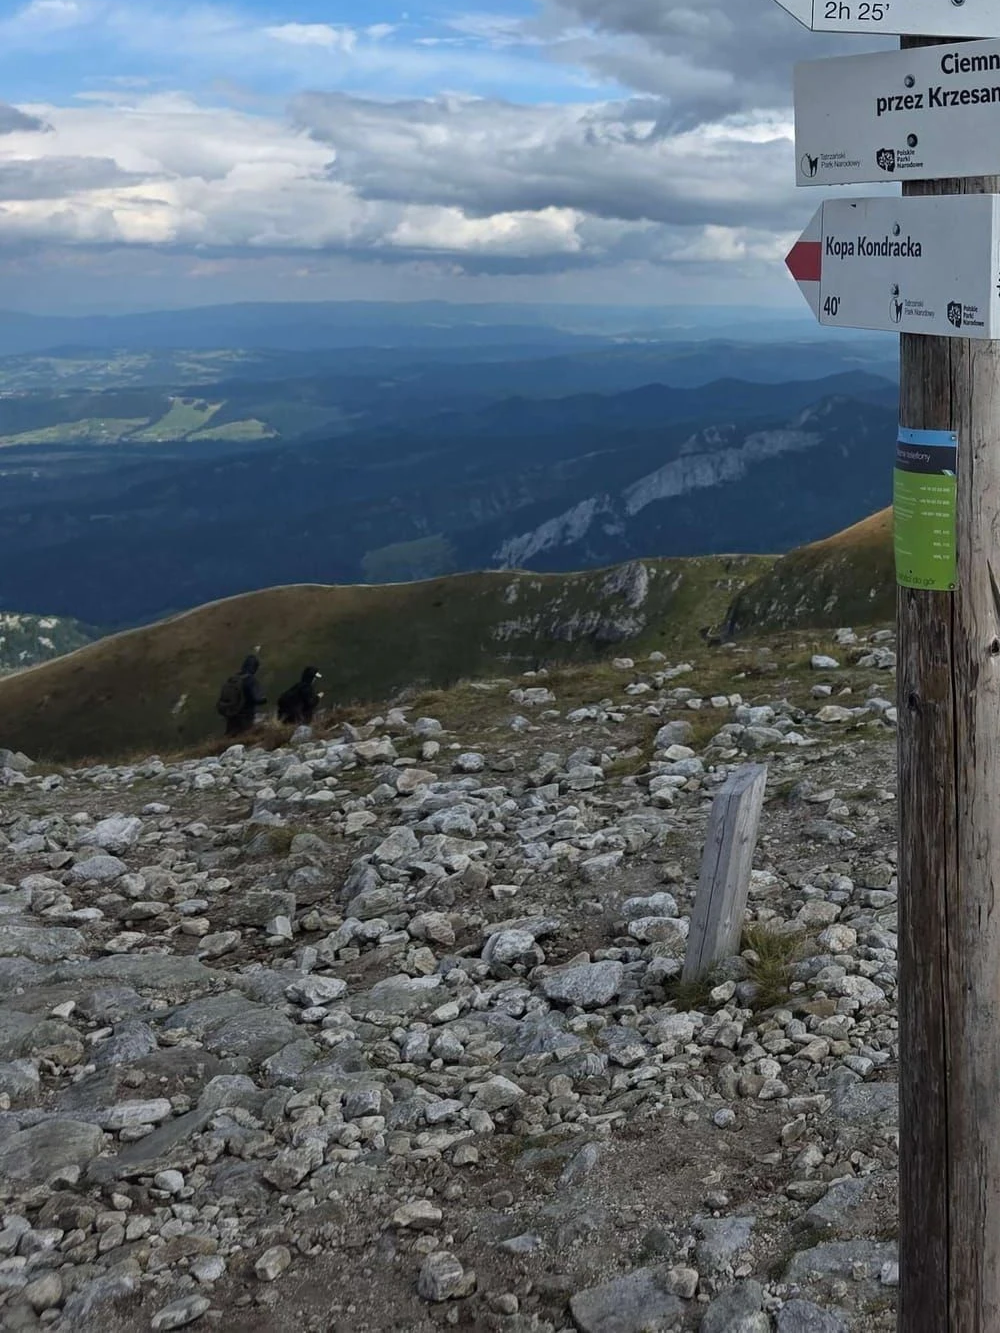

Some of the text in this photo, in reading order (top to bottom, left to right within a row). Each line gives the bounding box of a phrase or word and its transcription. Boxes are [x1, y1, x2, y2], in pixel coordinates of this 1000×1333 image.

[824, 1, 850, 20] 2h
[876, 93, 924, 116] przez
[825, 235, 922, 260] Kopa Kondracka
